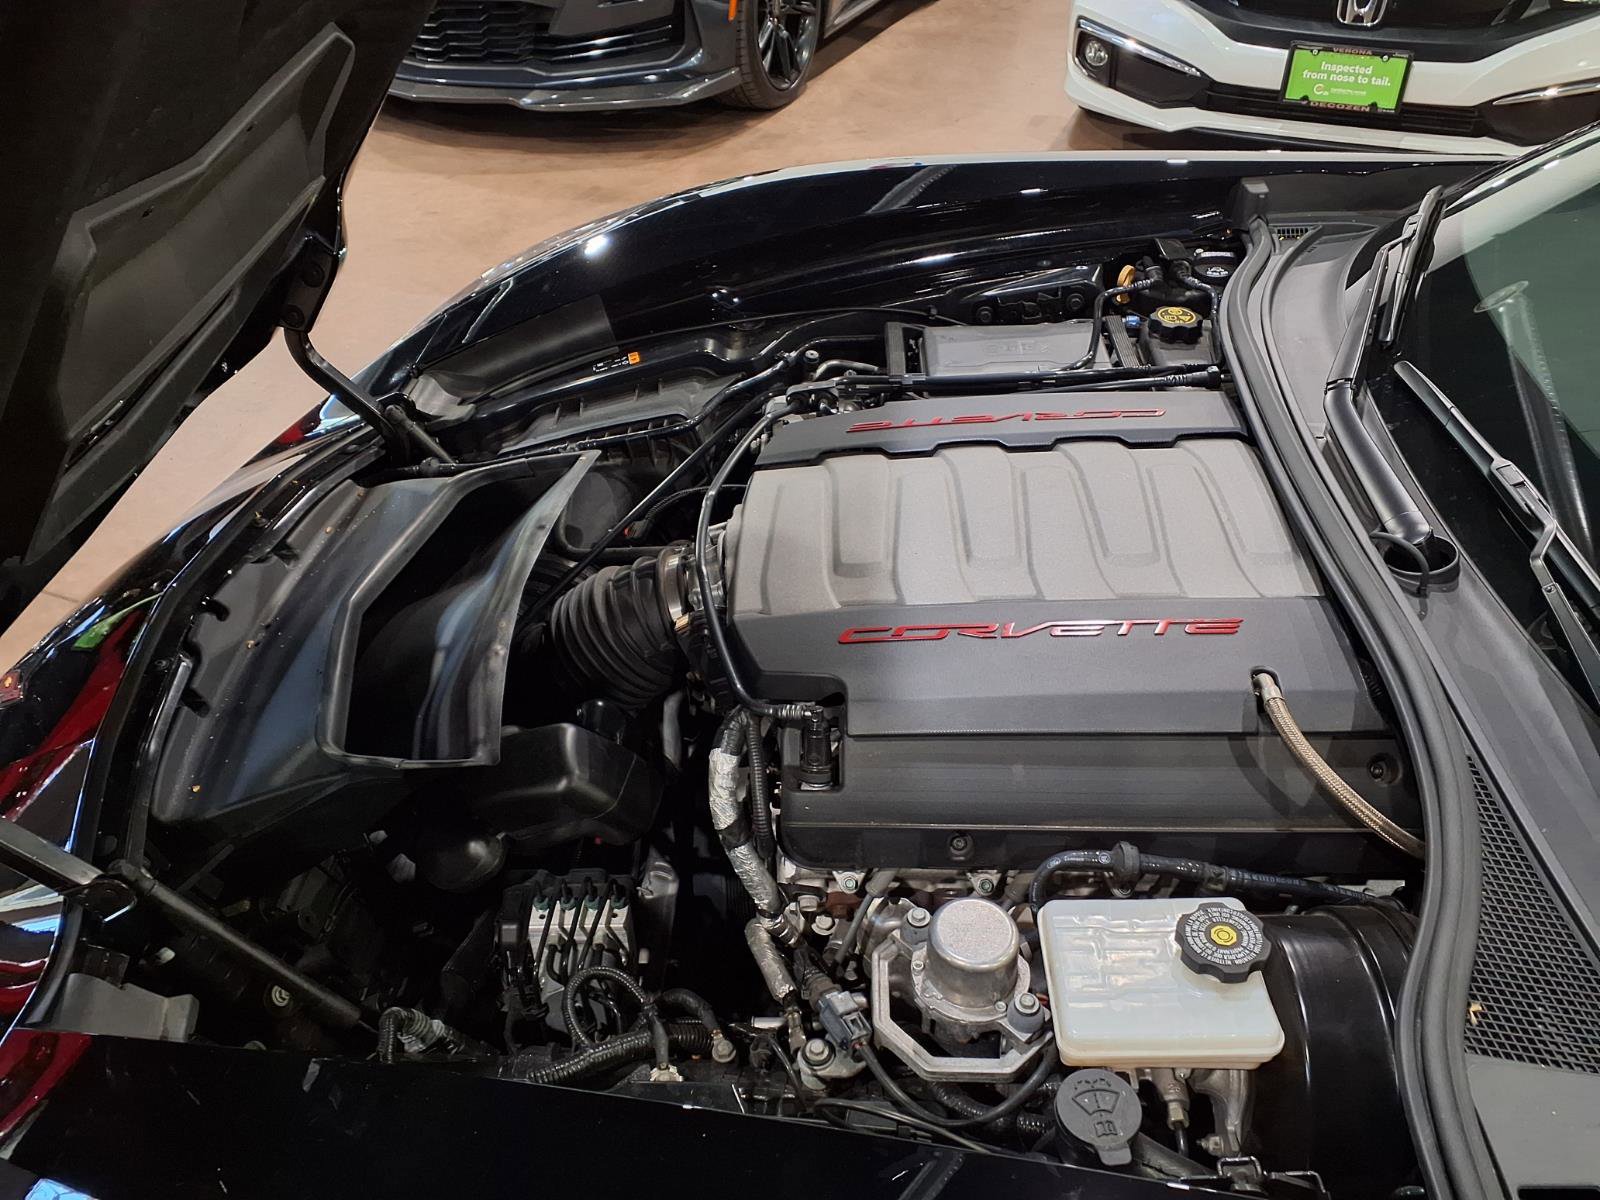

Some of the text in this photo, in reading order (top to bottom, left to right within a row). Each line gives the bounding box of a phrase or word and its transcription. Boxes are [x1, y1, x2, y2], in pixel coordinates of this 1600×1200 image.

[1333, 47, 1373, 55] VERONA
[1321, 61, 1373, 74] Inspected
[1303, 70, 1391, 86] from nose to tail.
[1310, 101, 1370, 112] DECOZEN
[846, 408, 1167, 432] CORVETTE
[838, 617, 1243, 645] CORVETTE
